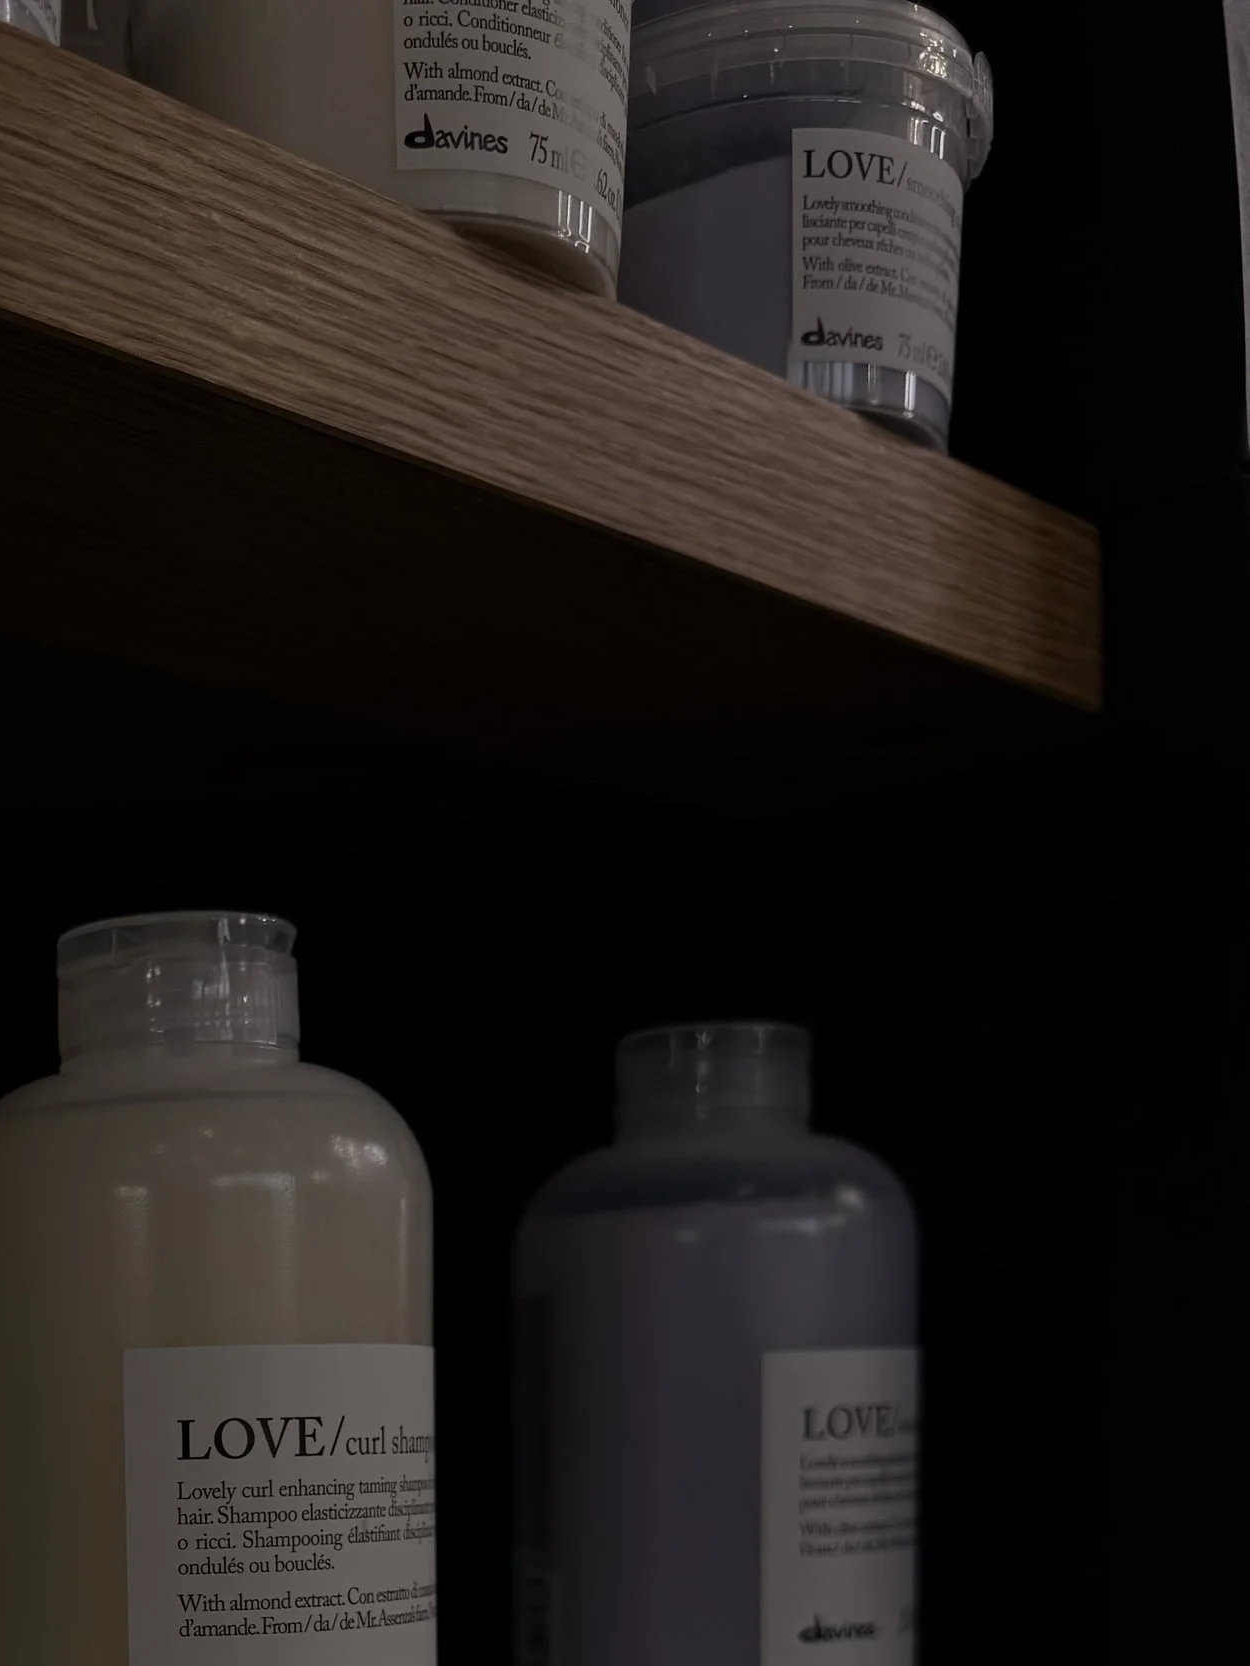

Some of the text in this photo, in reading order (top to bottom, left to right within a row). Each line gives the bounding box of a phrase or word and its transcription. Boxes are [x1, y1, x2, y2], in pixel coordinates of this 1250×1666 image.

[418, 10, 551, 44] ricci. Conditionneur
[404, 31, 532, 60] ondulés ou bouclés.
[404, 62, 544, 94] With almond extract.
[474, 86, 509, 107] From
[404, 112, 548, 165] davines 75
[803, 195, 839, 214] Lovely
[802, 235, 830, 250] pour
[803, 256, 834, 271] With
[801, 316, 883, 351] davines
[177, 1475, 397, 1504] Lovely curl enhancing taming
[177, 1502, 386, 1535] hair. Shampoo elasticizzante
[196, 1524, 401, 1556] ricci. Shampooing élastifiant
[177, 1553, 335, 1576] ondulés ou bouclés.
[179, 1586, 374, 1613] With almond extract. Con
[179, 1615, 303, 1638] d'amande. From
